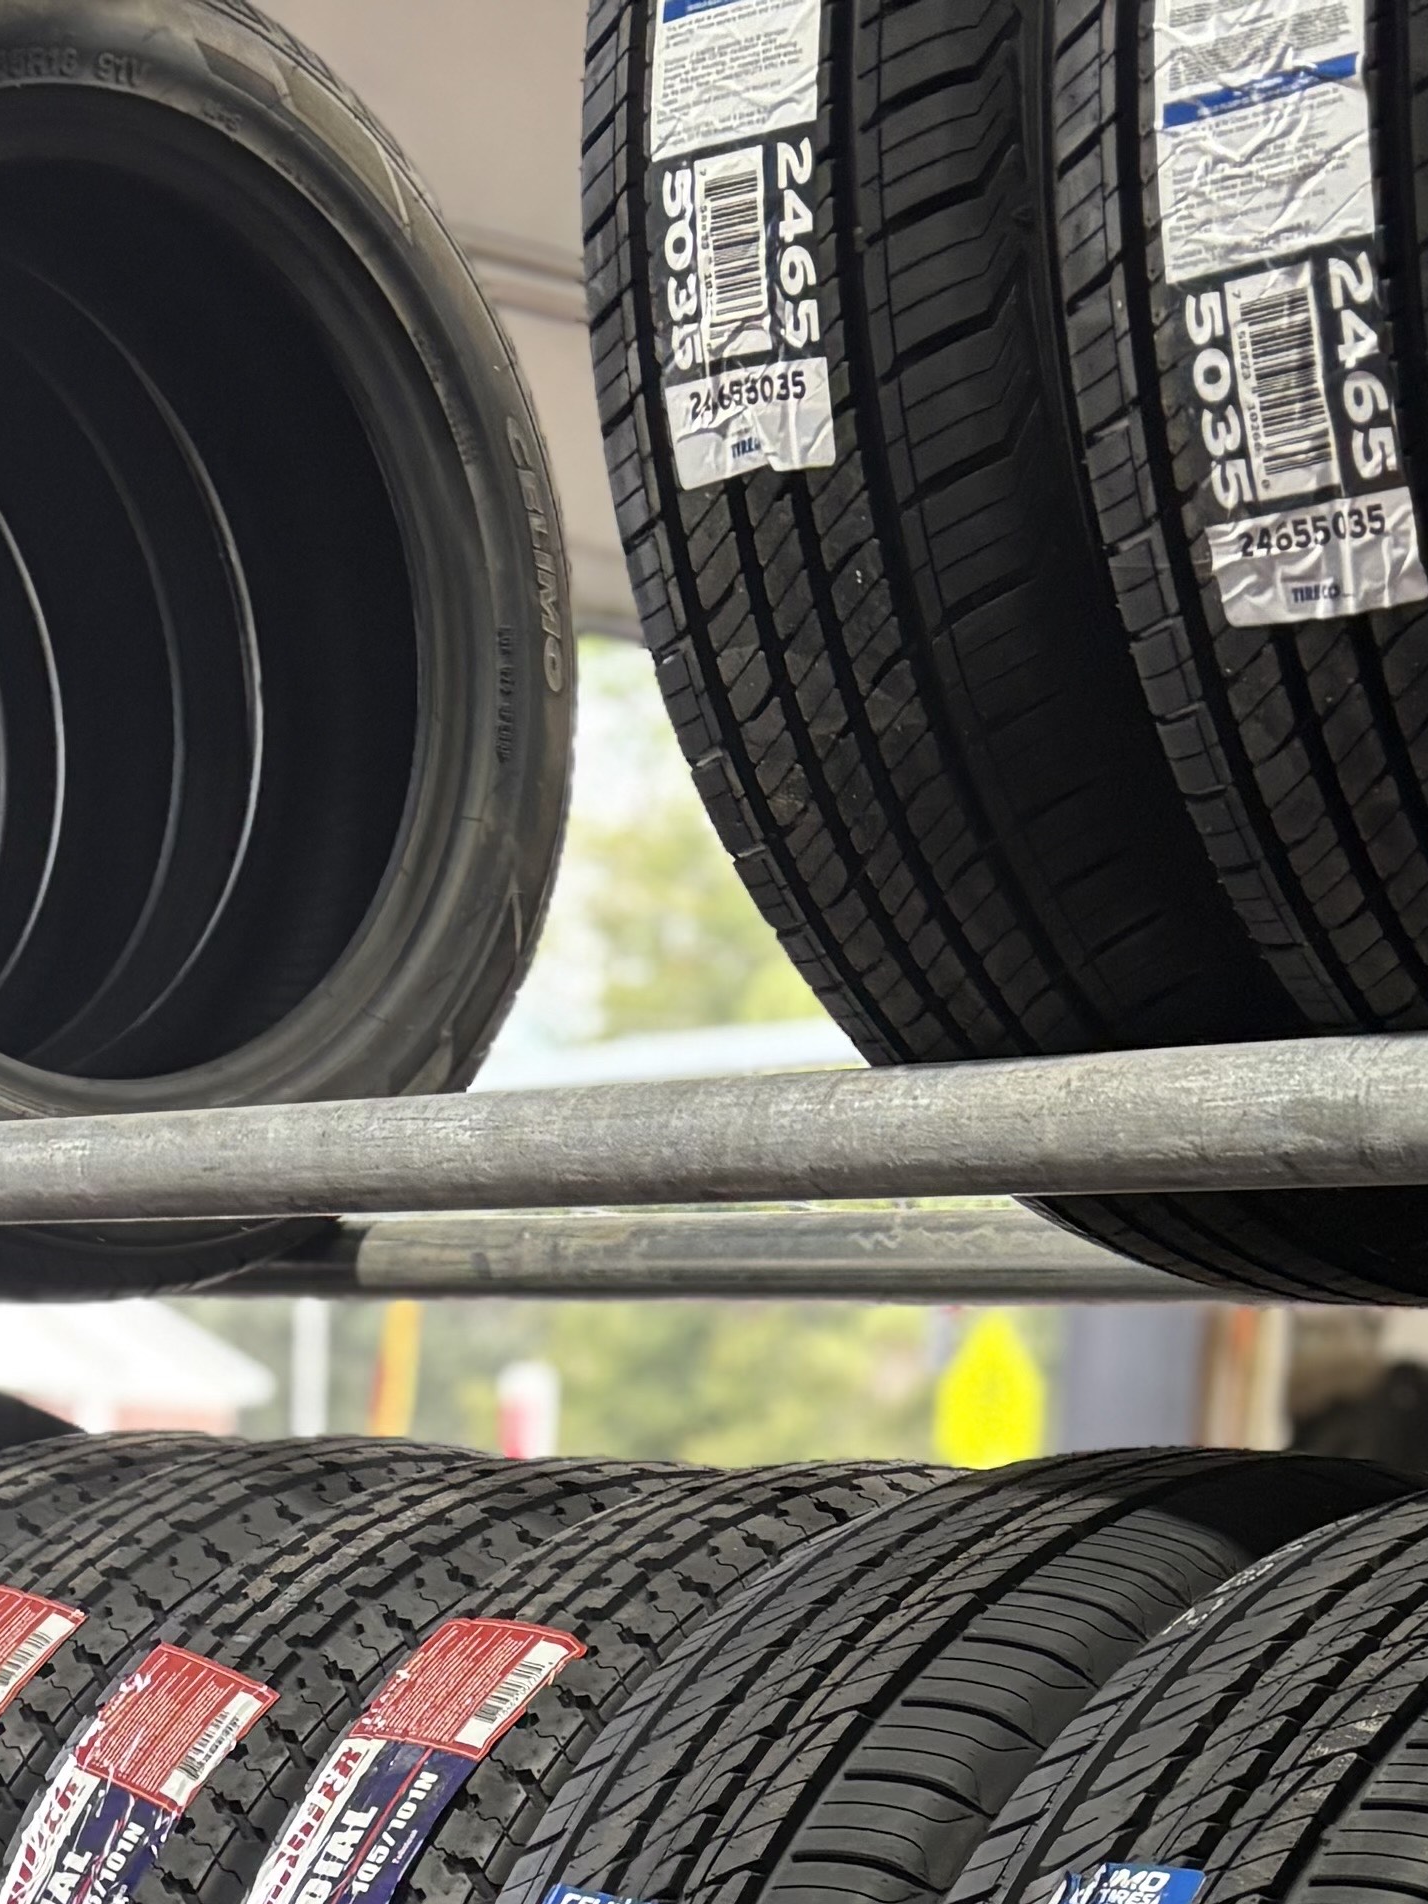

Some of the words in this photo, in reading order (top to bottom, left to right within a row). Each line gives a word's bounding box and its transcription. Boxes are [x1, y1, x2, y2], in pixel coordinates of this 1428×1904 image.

[662, 168, 704, 371] 5035
[776, 137, 820, 349] 2465
[1186, 292, 1253, 509] 5035
[1328, 252, 1397, 479] 2465
[507, 416, 563, 692] CELIMO
[1239, 504, 1385, 557] 24655035
[351, 1771, 439, 1897] 105/101N
